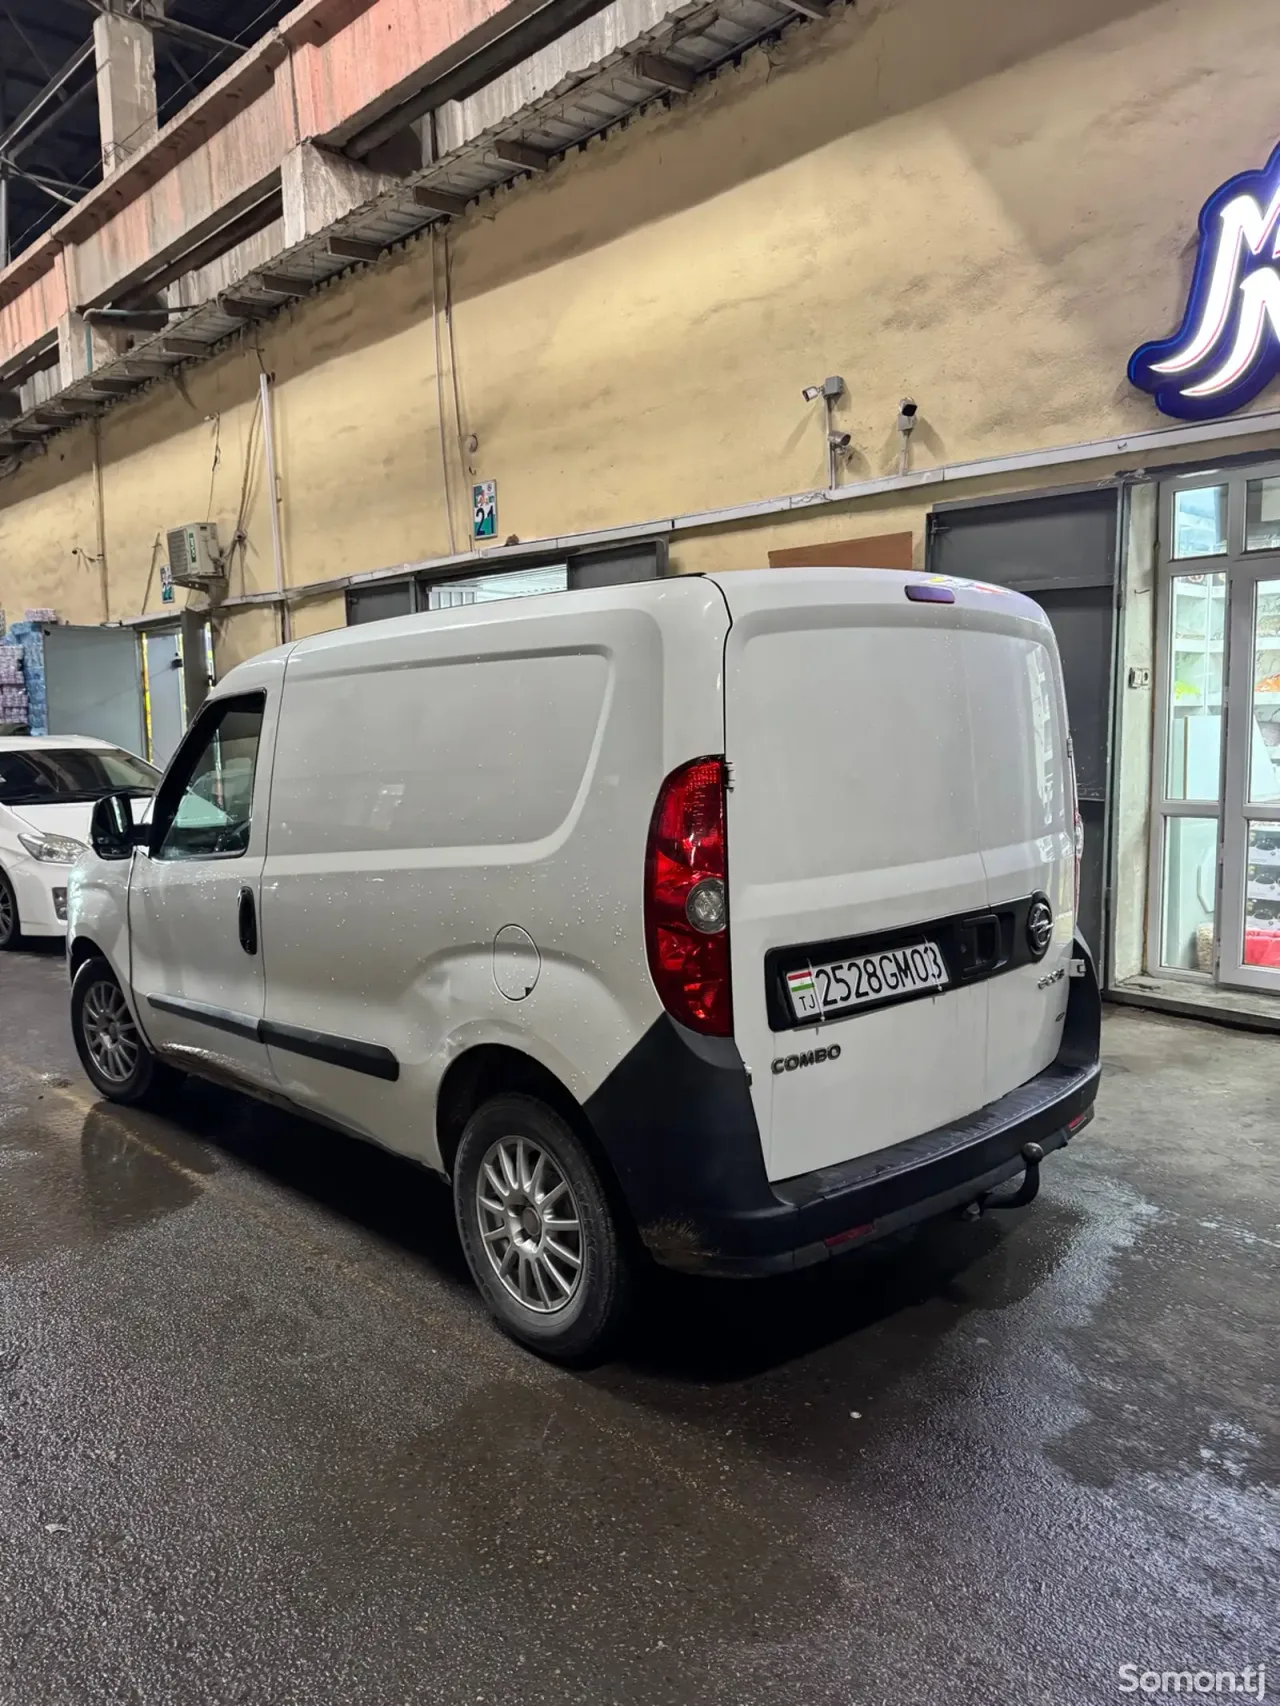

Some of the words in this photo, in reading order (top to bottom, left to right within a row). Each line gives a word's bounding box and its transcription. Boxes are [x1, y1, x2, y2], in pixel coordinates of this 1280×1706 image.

[475, 505, 495, 536] 21
[814, 945, 943, 1008] 2528GM03
[798, 993, 816, 1012] TJ
[770, 1043, 842, 1076] COMBO
